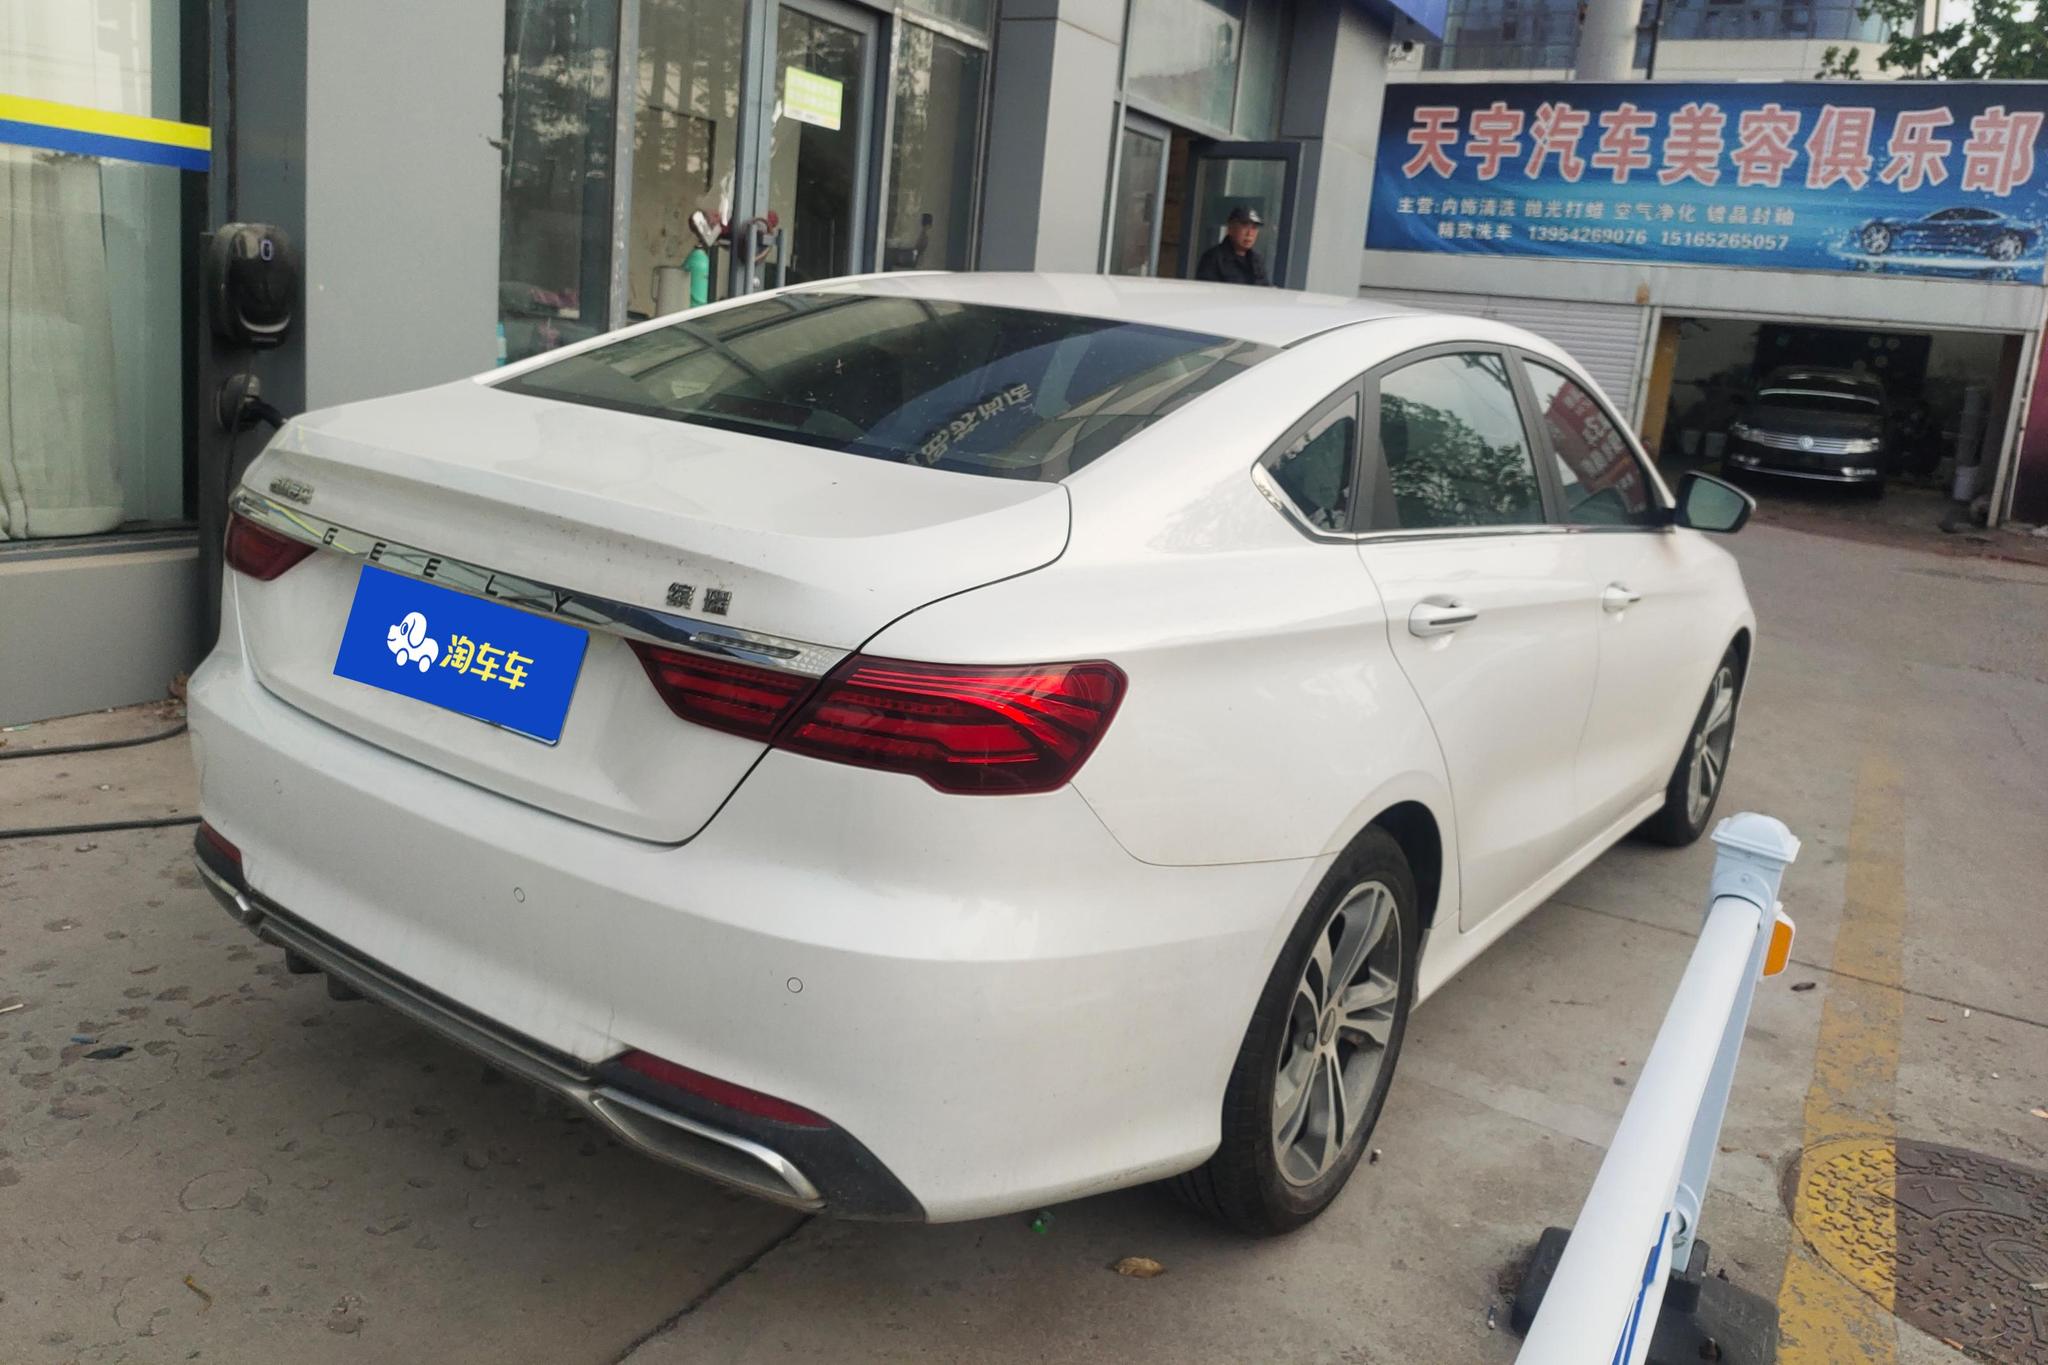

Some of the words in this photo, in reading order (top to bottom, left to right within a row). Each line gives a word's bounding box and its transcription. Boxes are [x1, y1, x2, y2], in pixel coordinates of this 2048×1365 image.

[1402, 103, 2043, 196] 天宇汽车美容俱乐部
[1437, 221, 1512, 241] 精致洗车
[1661, 229, 1790, 250] 15165265057
[1613, 202, 1697, 222] 空气净化
[322, 527, 572, 613] GEELY
